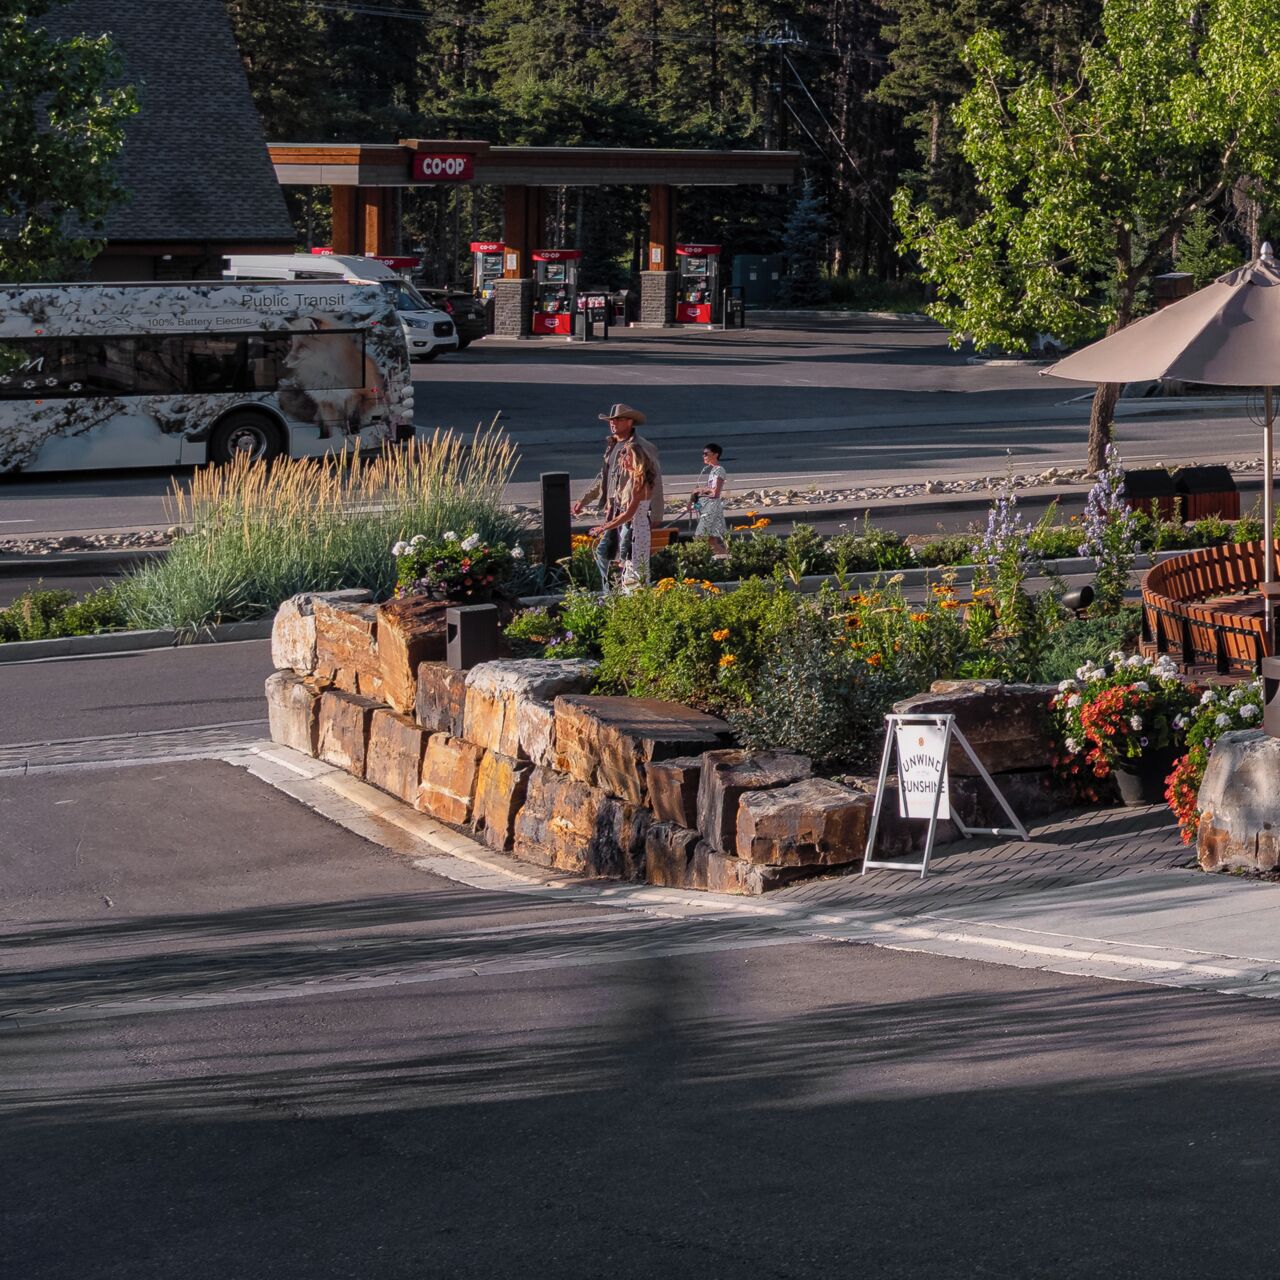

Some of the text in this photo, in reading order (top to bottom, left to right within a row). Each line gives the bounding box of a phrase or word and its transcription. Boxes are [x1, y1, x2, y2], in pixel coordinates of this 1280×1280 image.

[423, 158, 465, 175] CO-OP
[242, 293, 346, 307] Public Transit
[148, 317, 250, 328] 100% Battery Electric
